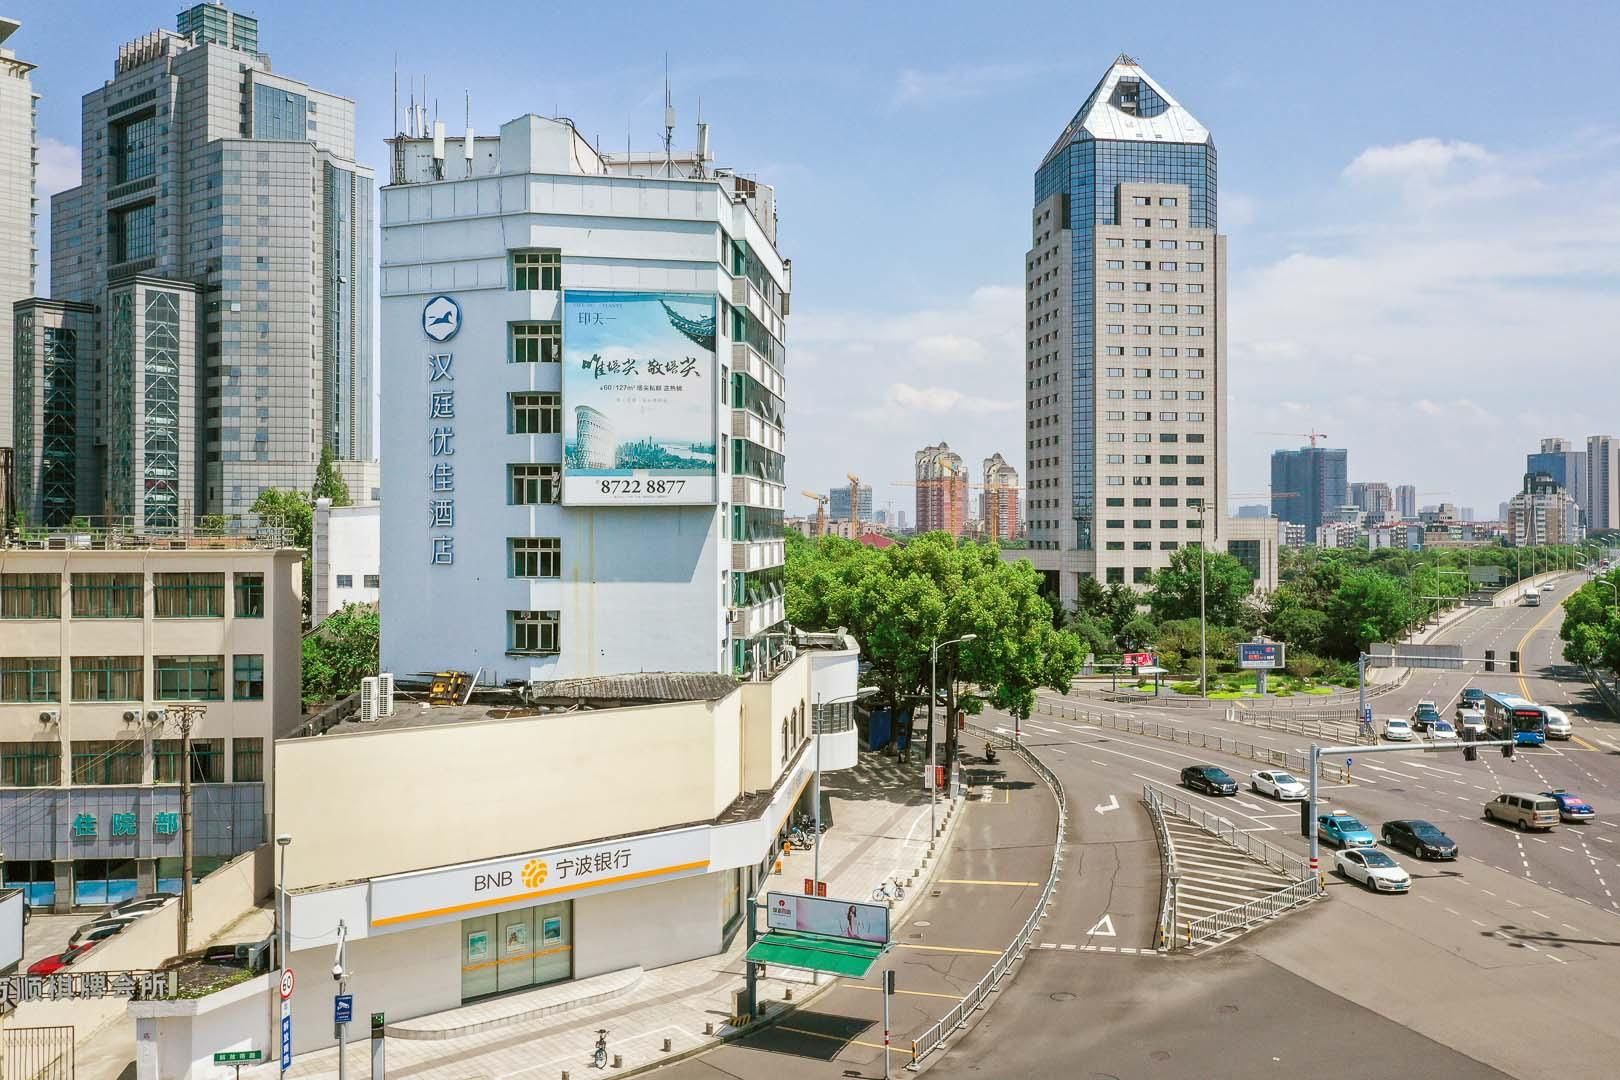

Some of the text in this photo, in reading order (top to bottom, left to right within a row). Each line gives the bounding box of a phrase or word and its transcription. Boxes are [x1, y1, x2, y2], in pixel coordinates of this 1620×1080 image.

[428, 352, 455, 565] 汉庭优佳酒店
[601, 479, 686, 495] 8722 8877
[72, 811, 180, 836] 住院部
[555, 848, 632, 880] 宁波银行
[474, 870, 513, 892] BNB
[282, 975, 291, 992] 60
